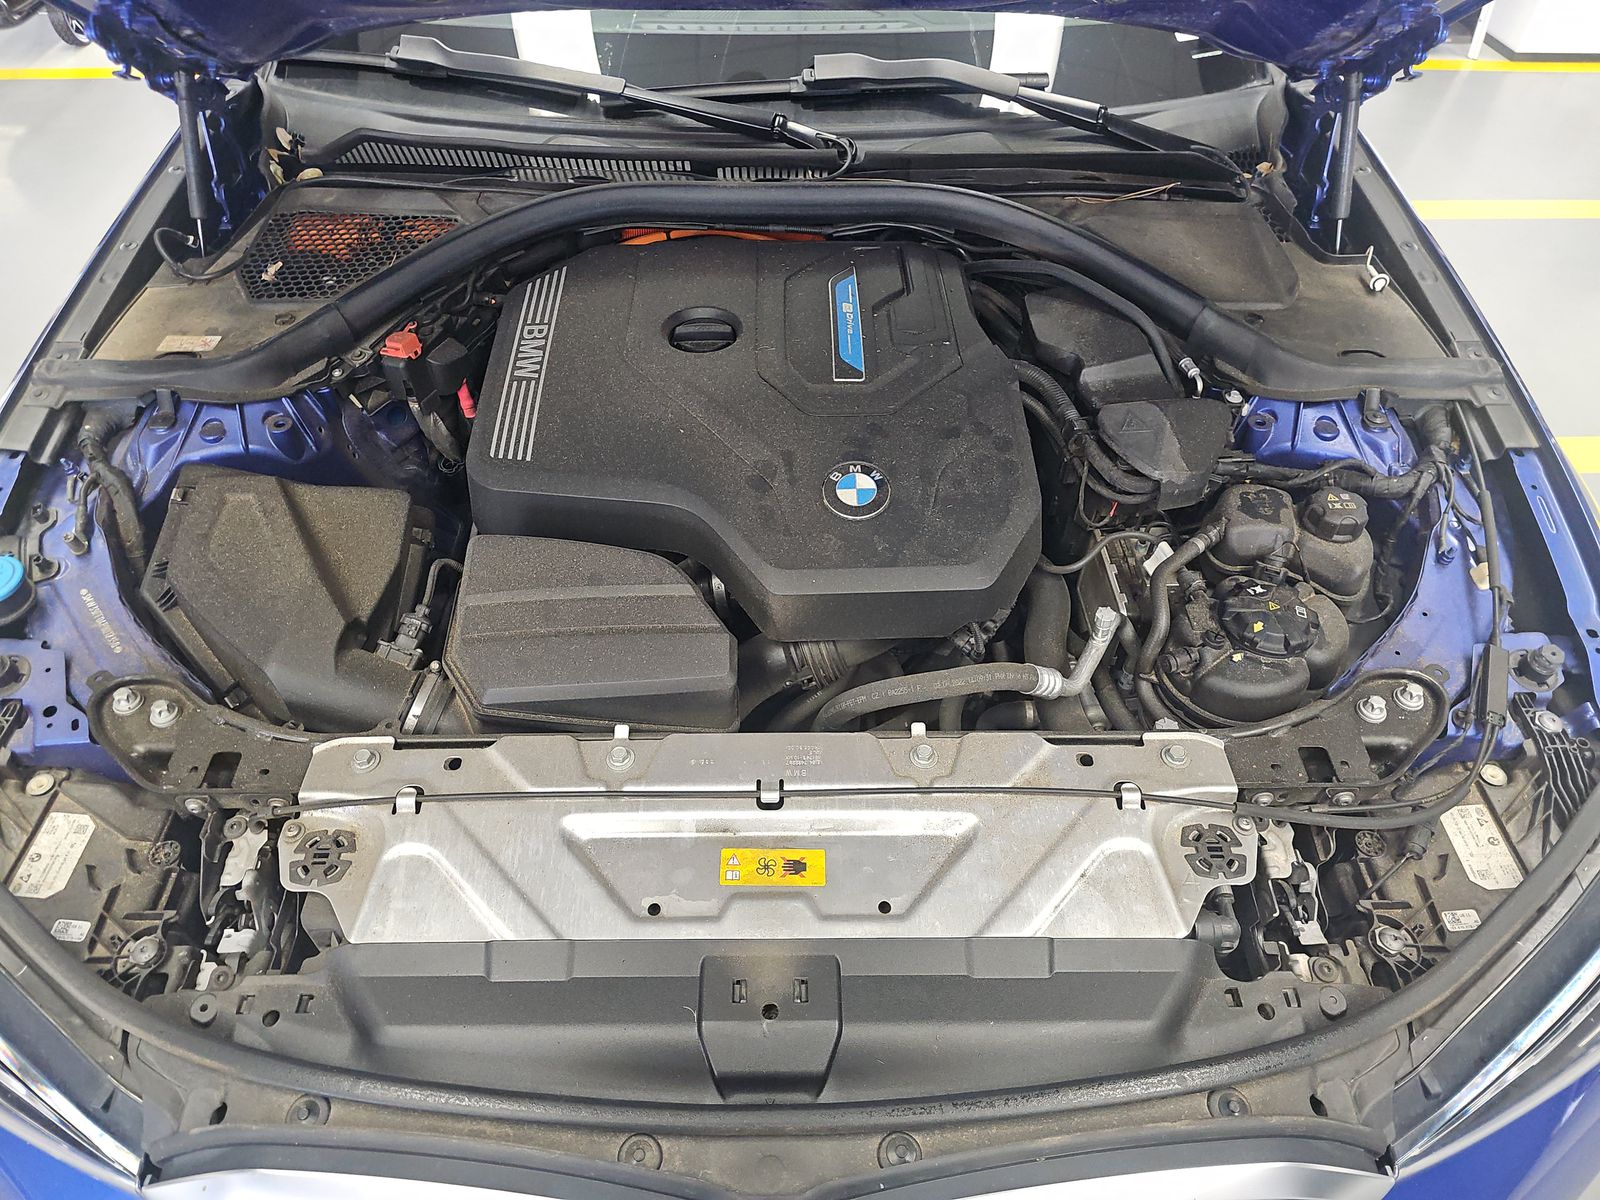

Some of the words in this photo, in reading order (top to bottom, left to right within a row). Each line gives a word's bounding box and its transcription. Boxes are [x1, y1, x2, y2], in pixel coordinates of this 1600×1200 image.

[513, 324, 549, 378] BMW
[829, 464, 883, 482] BMW
[785, 769, 807, 777] BMW
